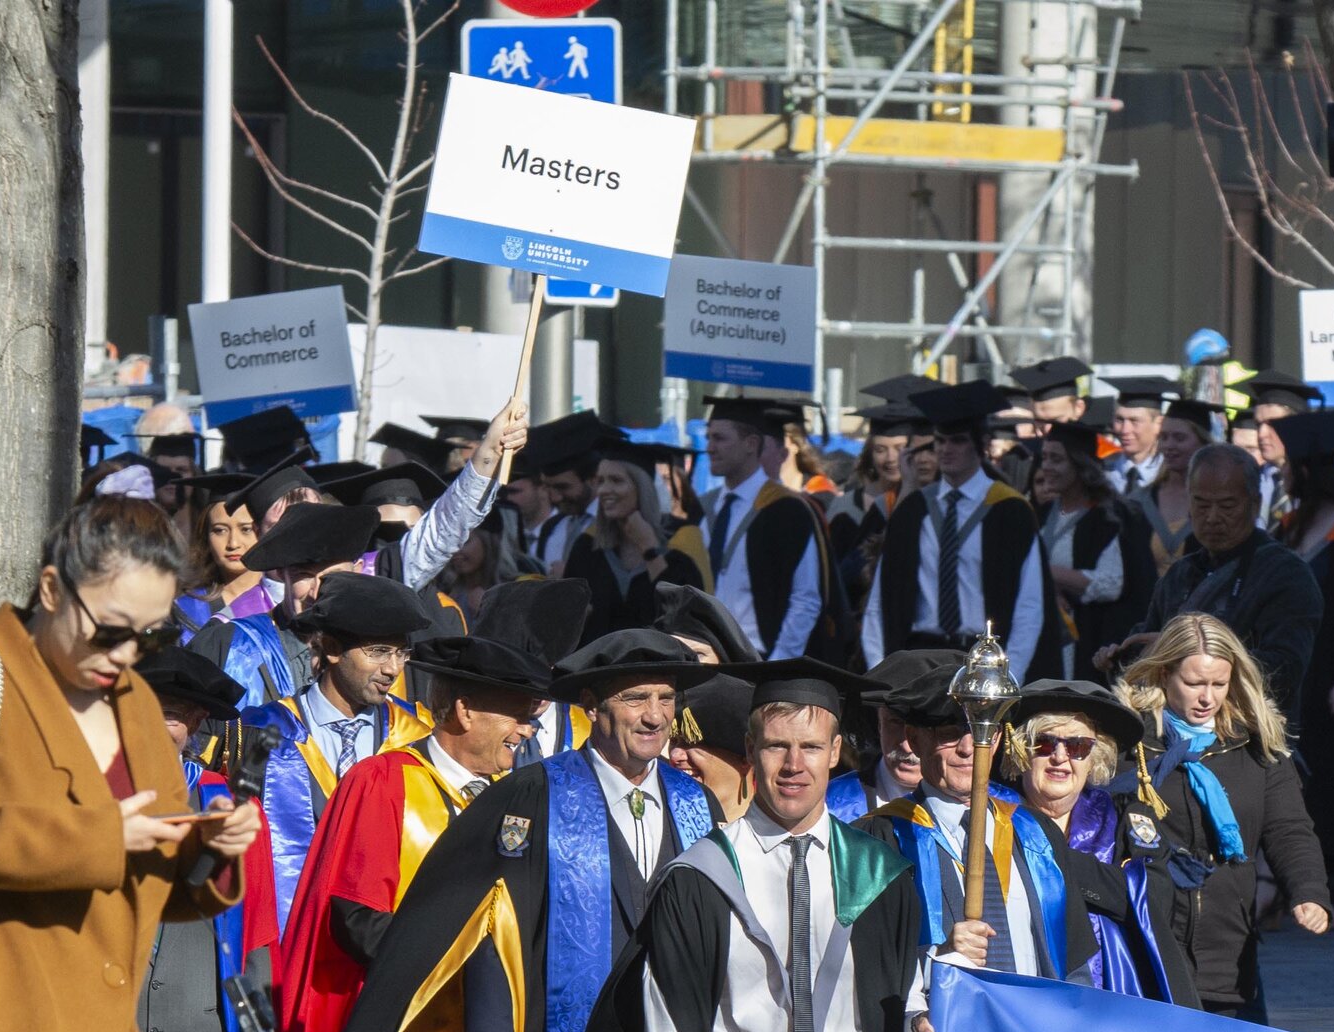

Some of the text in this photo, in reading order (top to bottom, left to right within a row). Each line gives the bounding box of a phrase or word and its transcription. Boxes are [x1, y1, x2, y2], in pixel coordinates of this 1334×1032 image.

[502, 145, 620, 190] Masters
[527, 249, 589, 266] UNIVERSITY
[528, 242, 572, 256] LINCOLN
[696, 278, 782, 300] Bachelor of
[697, 299, 780, 321] Commerce
[220, 319, 315, 348] Bachelor of
[690, 318, 786, 345] (Agriculture)
[225, 346, 319, 370] Commerce
